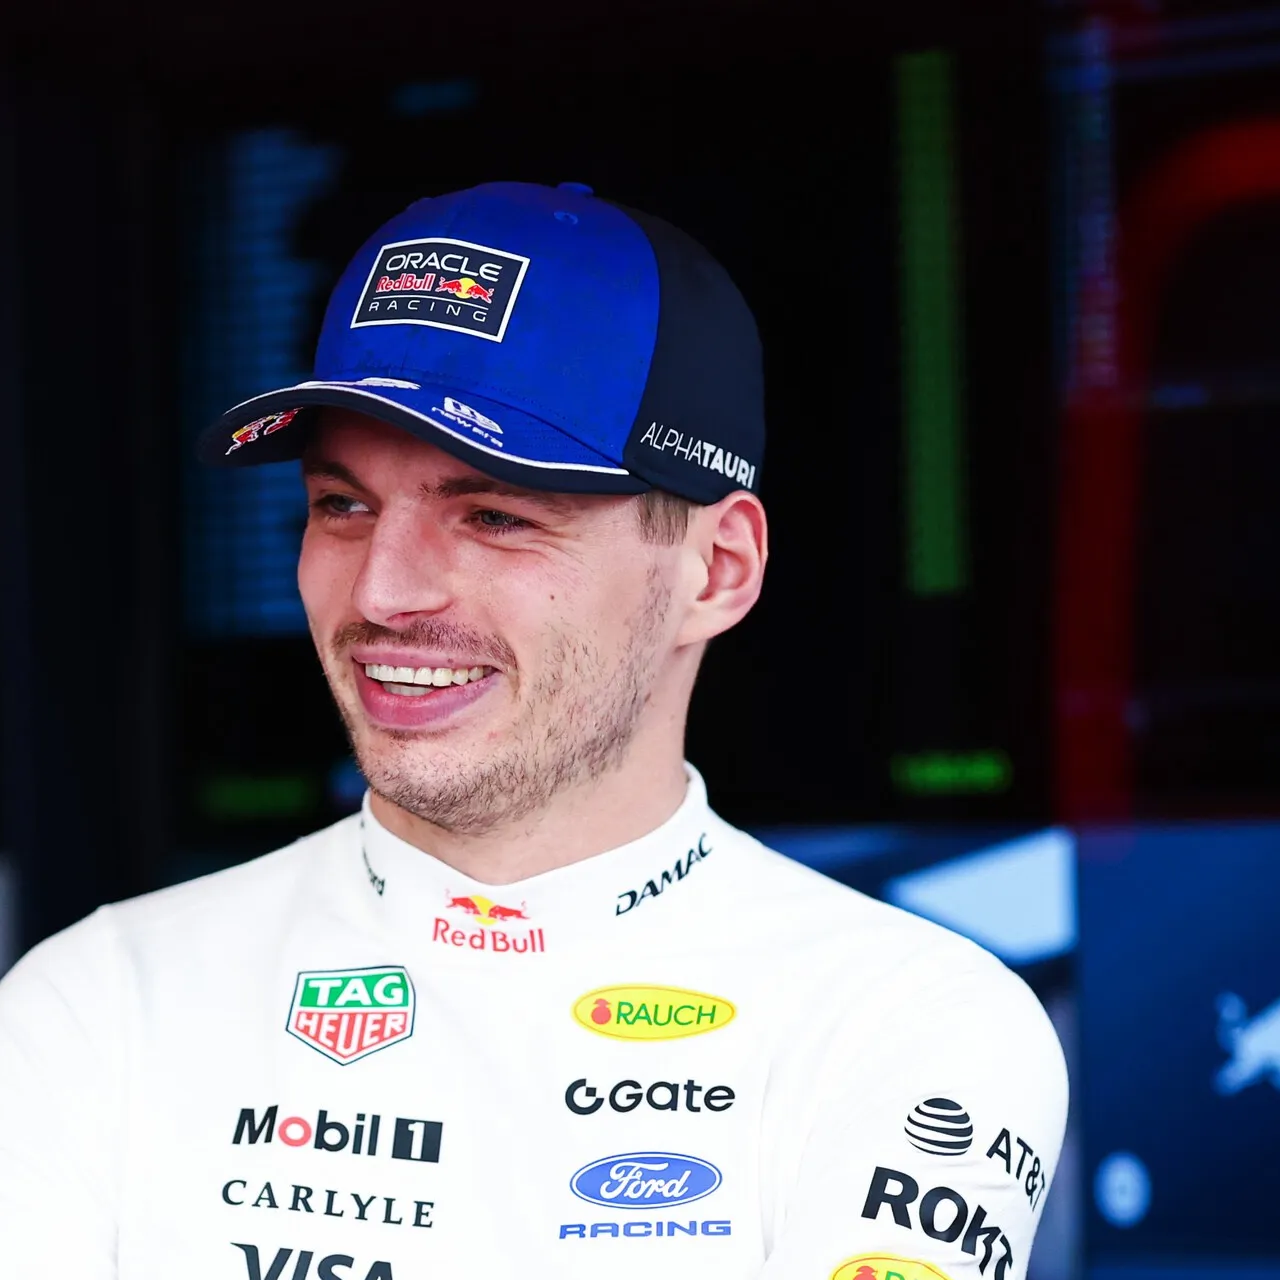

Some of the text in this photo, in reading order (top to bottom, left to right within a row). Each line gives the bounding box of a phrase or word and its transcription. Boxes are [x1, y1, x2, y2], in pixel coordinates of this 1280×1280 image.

[376, 273, 435, 293] Red Bull
[385, 252, 503, 281] ORACLE
[368, 298, 488, 323] RACING
[639, 420, 757, 490] ALPHATAURI
[615, 832, 714, 916] DAMAC
[431, 917, 546, 954] Red Bull
[308, 974, 406, 1008] TAG
[615, 1000, 717, 1028] RAUCH
[295, 1010, 408, 1057] HEUER
[231, 1105, 380, 1158] Mobil
[598, 1161, 689, 1200] Ford
[986, 1127, 1046, 1213] AT&T
[221, 1179, 435, 1229] CARLYLE
[559, 1219, 732, 1240] RACING
